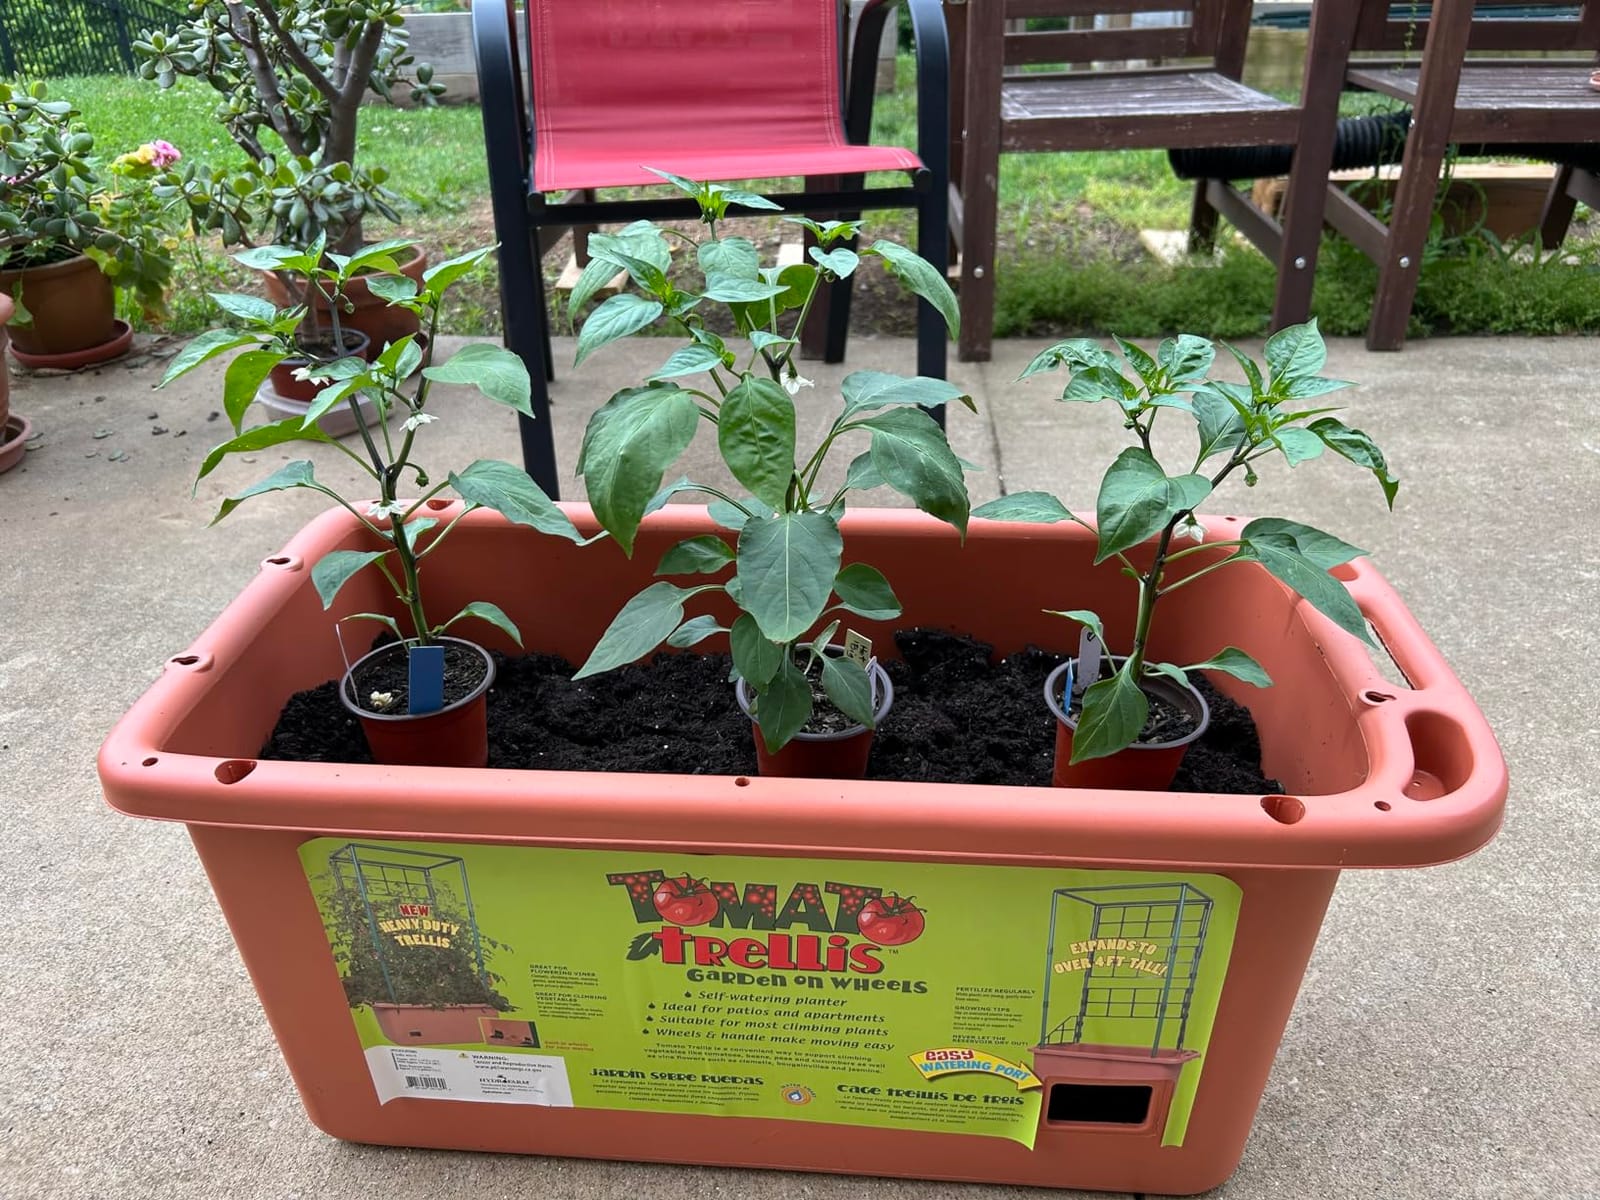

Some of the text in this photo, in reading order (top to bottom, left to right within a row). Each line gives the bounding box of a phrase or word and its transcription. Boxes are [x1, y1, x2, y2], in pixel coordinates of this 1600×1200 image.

[400, 904, 430, 916] NEW
[379, 919, 460, 935] HEAVY DUTY
[394, 934, 450, 948] TRELLIS
[1070, 939, 1157, 955] EXPANDS TO
[1054, 958, 1092, 974] OVER
[1095, 956, 1104, 967] 4
[1106, 956, 1126, 966] FT
[698, 990, 847, 1006] Self-watering planter
[663, 1002, 885, 1022] Ideal for patios and apartments
[659, 1016, 889, 1036] Suitable for most climbing plants
[656, 1028, 701, 1038] Wheels
[721, 1031, 766, 1042] handle
[770, 1036, 806, 1044] make
[810, 1038, 860, 1048] moving
[864, 1042, 895, 1051] easy
[838, 1054, 872, 1062] climbing
[925, 1050, 974, 1060] easy
[920, 1061, 1031, 1080] WATERING PORT
